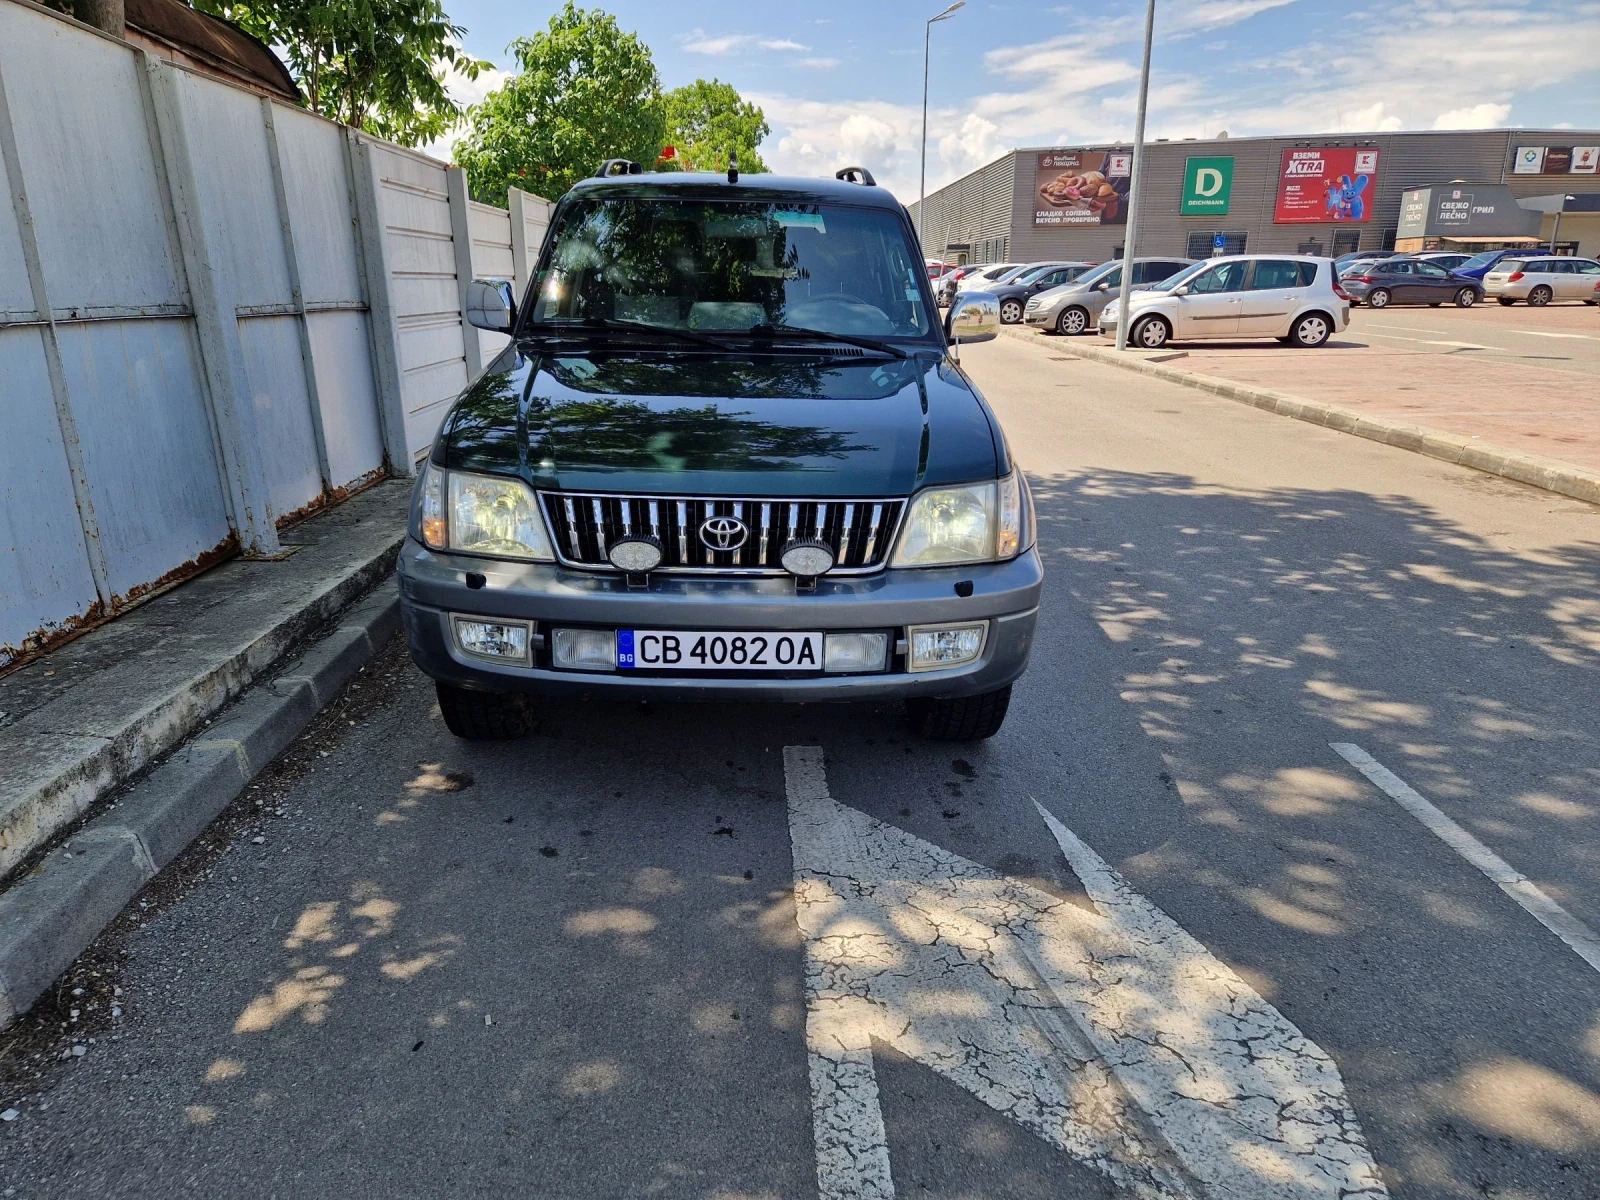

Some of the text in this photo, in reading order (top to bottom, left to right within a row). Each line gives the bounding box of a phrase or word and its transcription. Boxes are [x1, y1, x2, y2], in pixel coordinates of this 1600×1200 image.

[1285, 160, 1324, 173] XTRA
[1195, 168, 1223, 197] D
[1472, 206, 1495, 214] ГРИЛ
[640, 635, 682, 664] CB
[689, 636, 768, 665] 4082
[619, 653, 633, 662] BG
